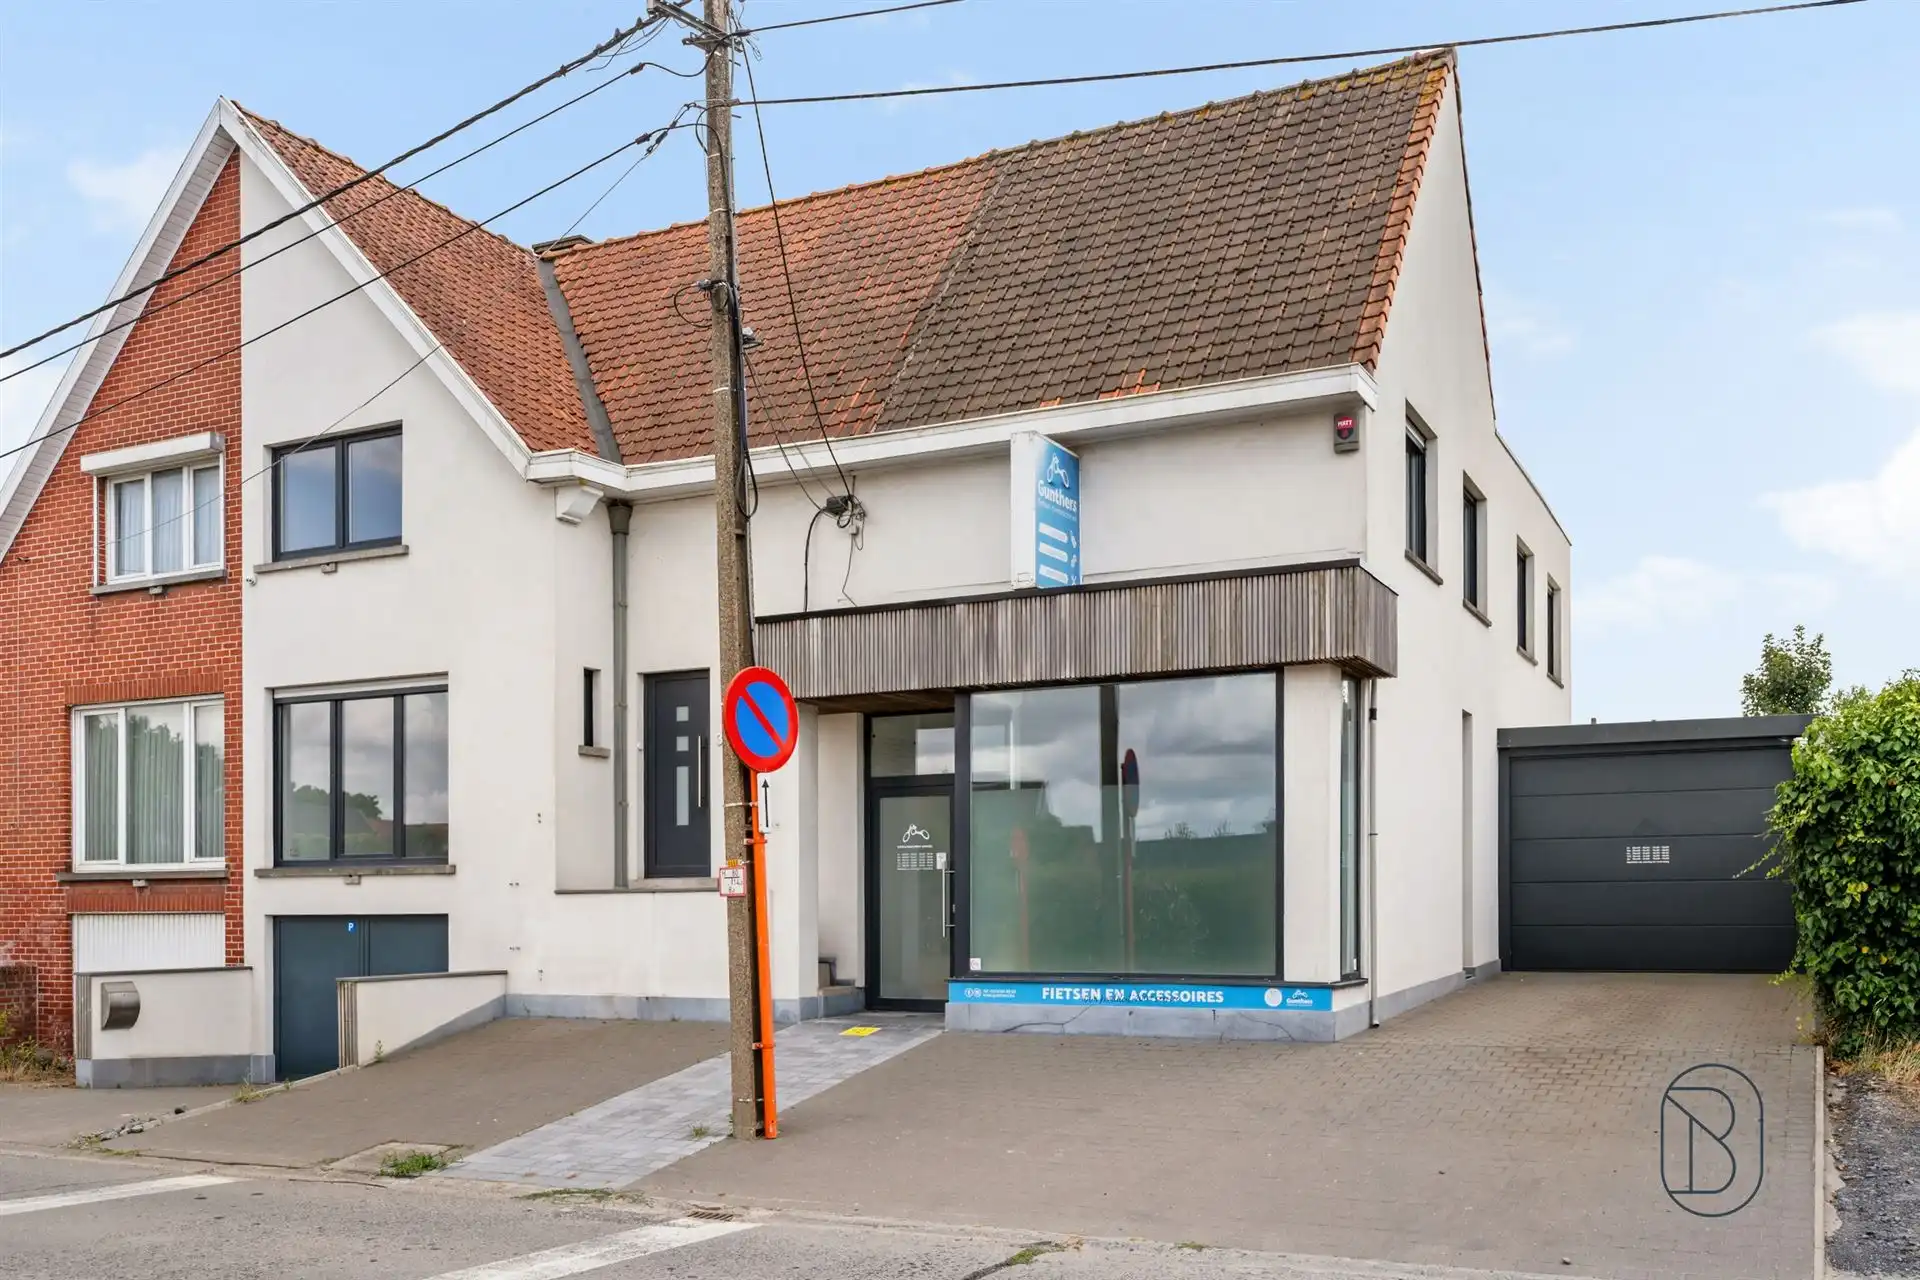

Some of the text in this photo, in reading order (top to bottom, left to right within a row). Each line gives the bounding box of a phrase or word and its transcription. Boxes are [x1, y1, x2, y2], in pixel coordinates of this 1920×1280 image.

[1038, 479, 1077, 512] Gunthers
[348, 922, 354, 932] P
[1042, 987, 1100, 1000] FIETSEN
[1105, 988, 1125, 1001] EN
[1129, 989, 1224, 1003] ACCESSOIRES
